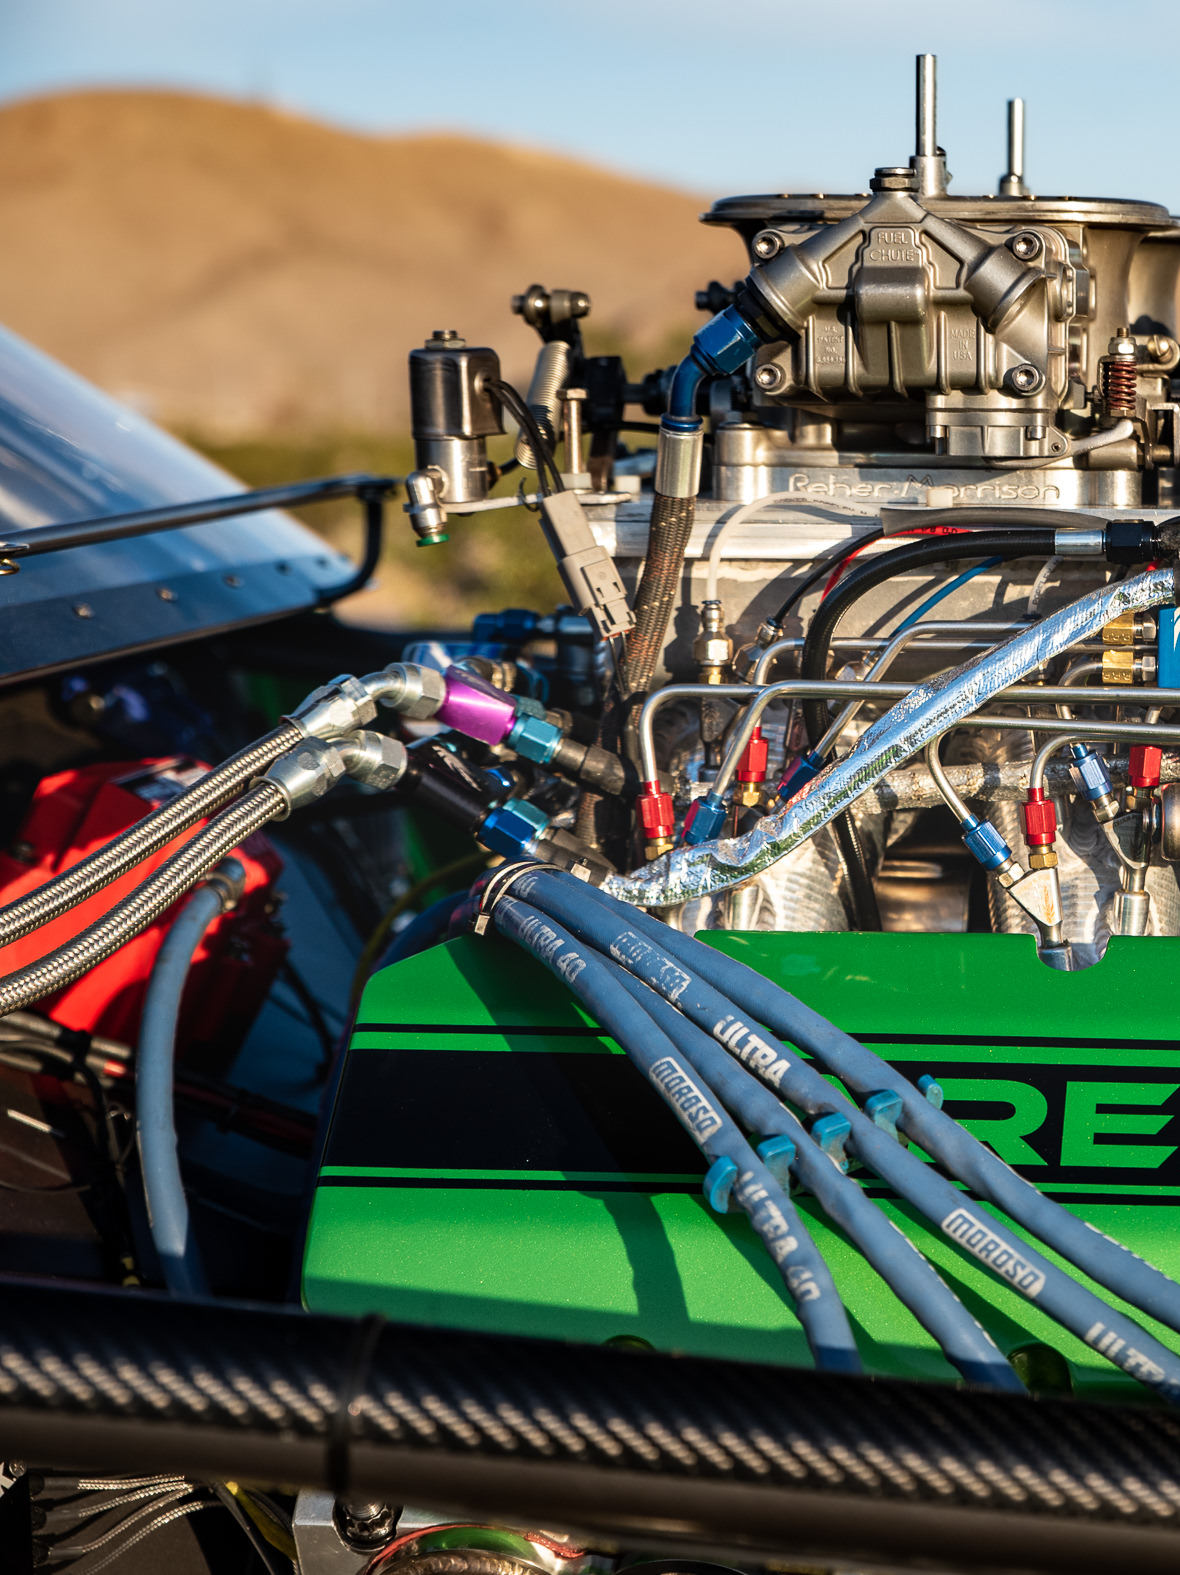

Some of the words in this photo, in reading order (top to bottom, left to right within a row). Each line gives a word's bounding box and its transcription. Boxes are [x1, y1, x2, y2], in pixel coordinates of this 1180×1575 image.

[878, 232, 908, 245] FUEL
[951, 329, 975, 340] MADE
[958, 340, 969, 351] IN
[952, 350, 973, 361] USA
[518, 915, 565, 960] ULTRA
[556, 952, 587, 984] 40
[713, 1014, 792, 1088] ULTRA
